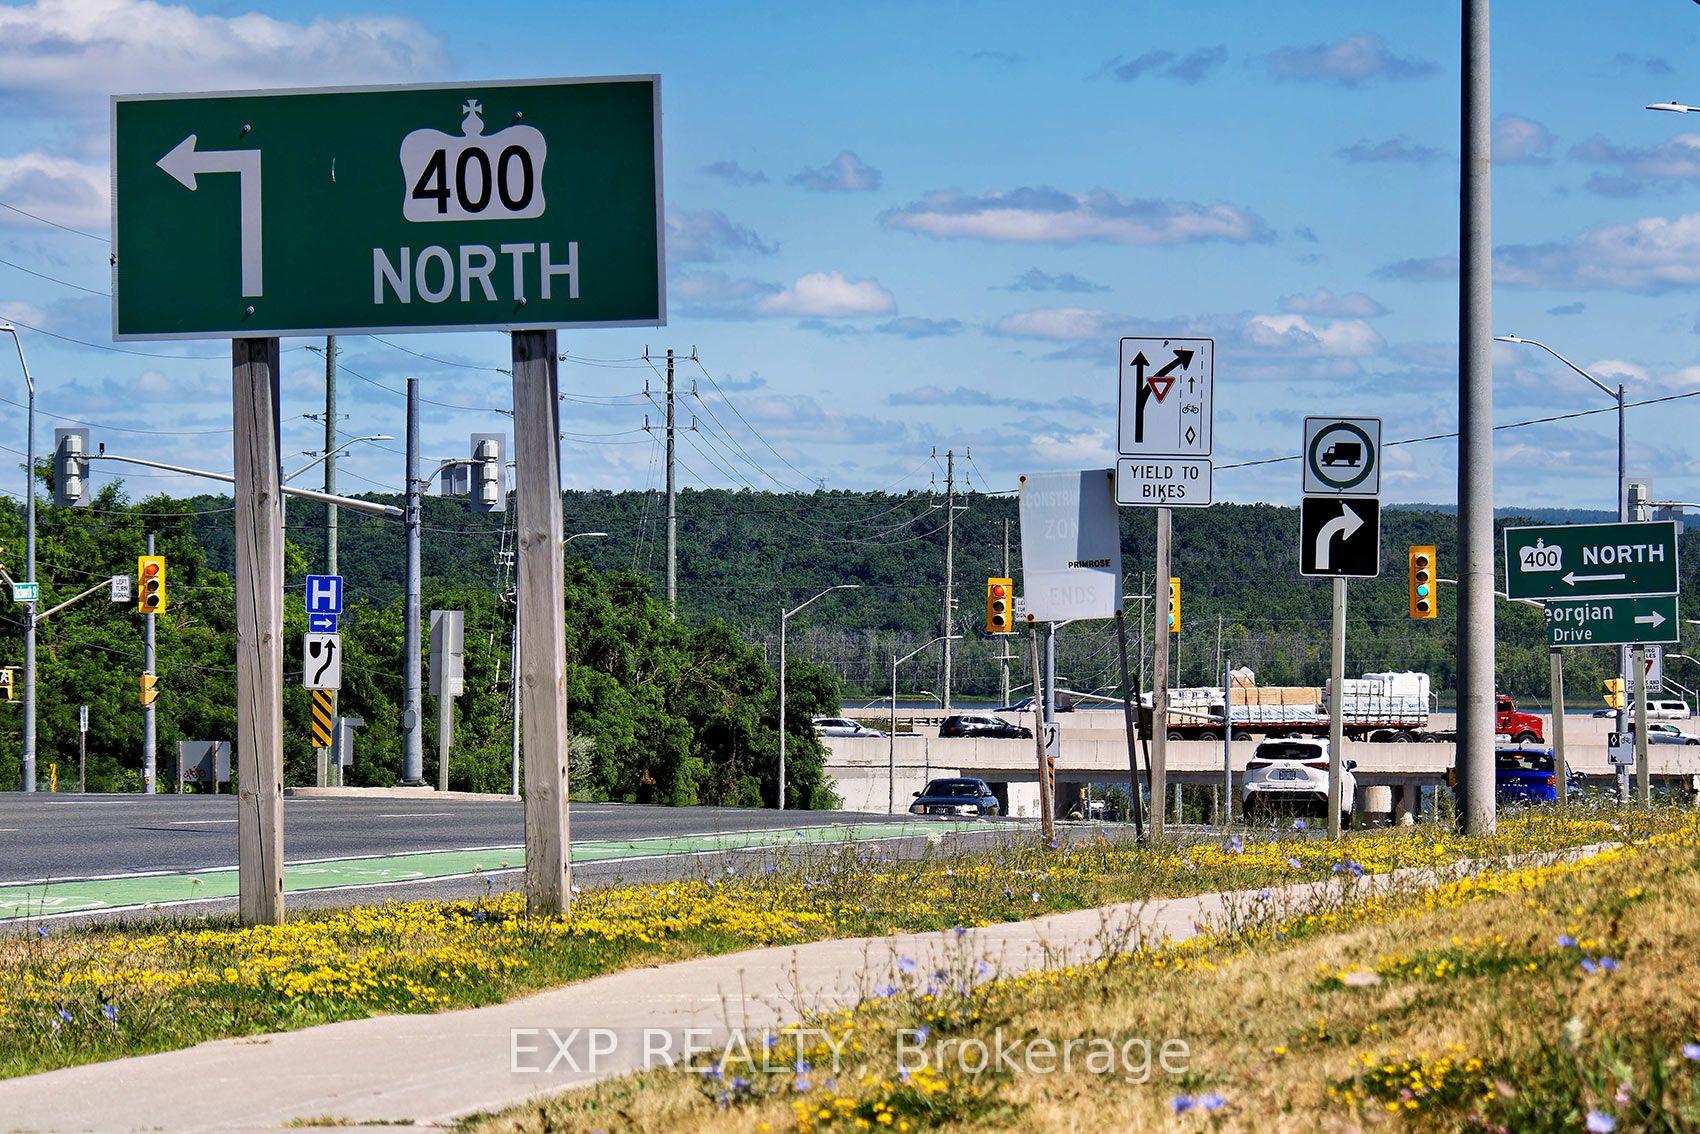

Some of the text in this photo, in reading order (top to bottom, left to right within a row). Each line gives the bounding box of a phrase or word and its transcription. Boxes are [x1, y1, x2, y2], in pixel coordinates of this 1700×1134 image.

[412, 144, 534, 214] 400
[373, 241, 580, 305] NORTH
[1130, 465, 1199, 480] YIELD TO
[1142, 484, 1185, 498] BIKES
[1044, 518, 1079, 539] ZON
[1068, 558, 1111, 569] PRIMROSE
[1524, 551, 1558, 567] 400
[1583, 543, 1665, 565] NORTH
[312, 579, 337, 610] H
[1049, 585, 1097, 606] ENDS
[1544, 603, 1613, 627] eorgian
[1553, 628, 1593, 642] Drive
